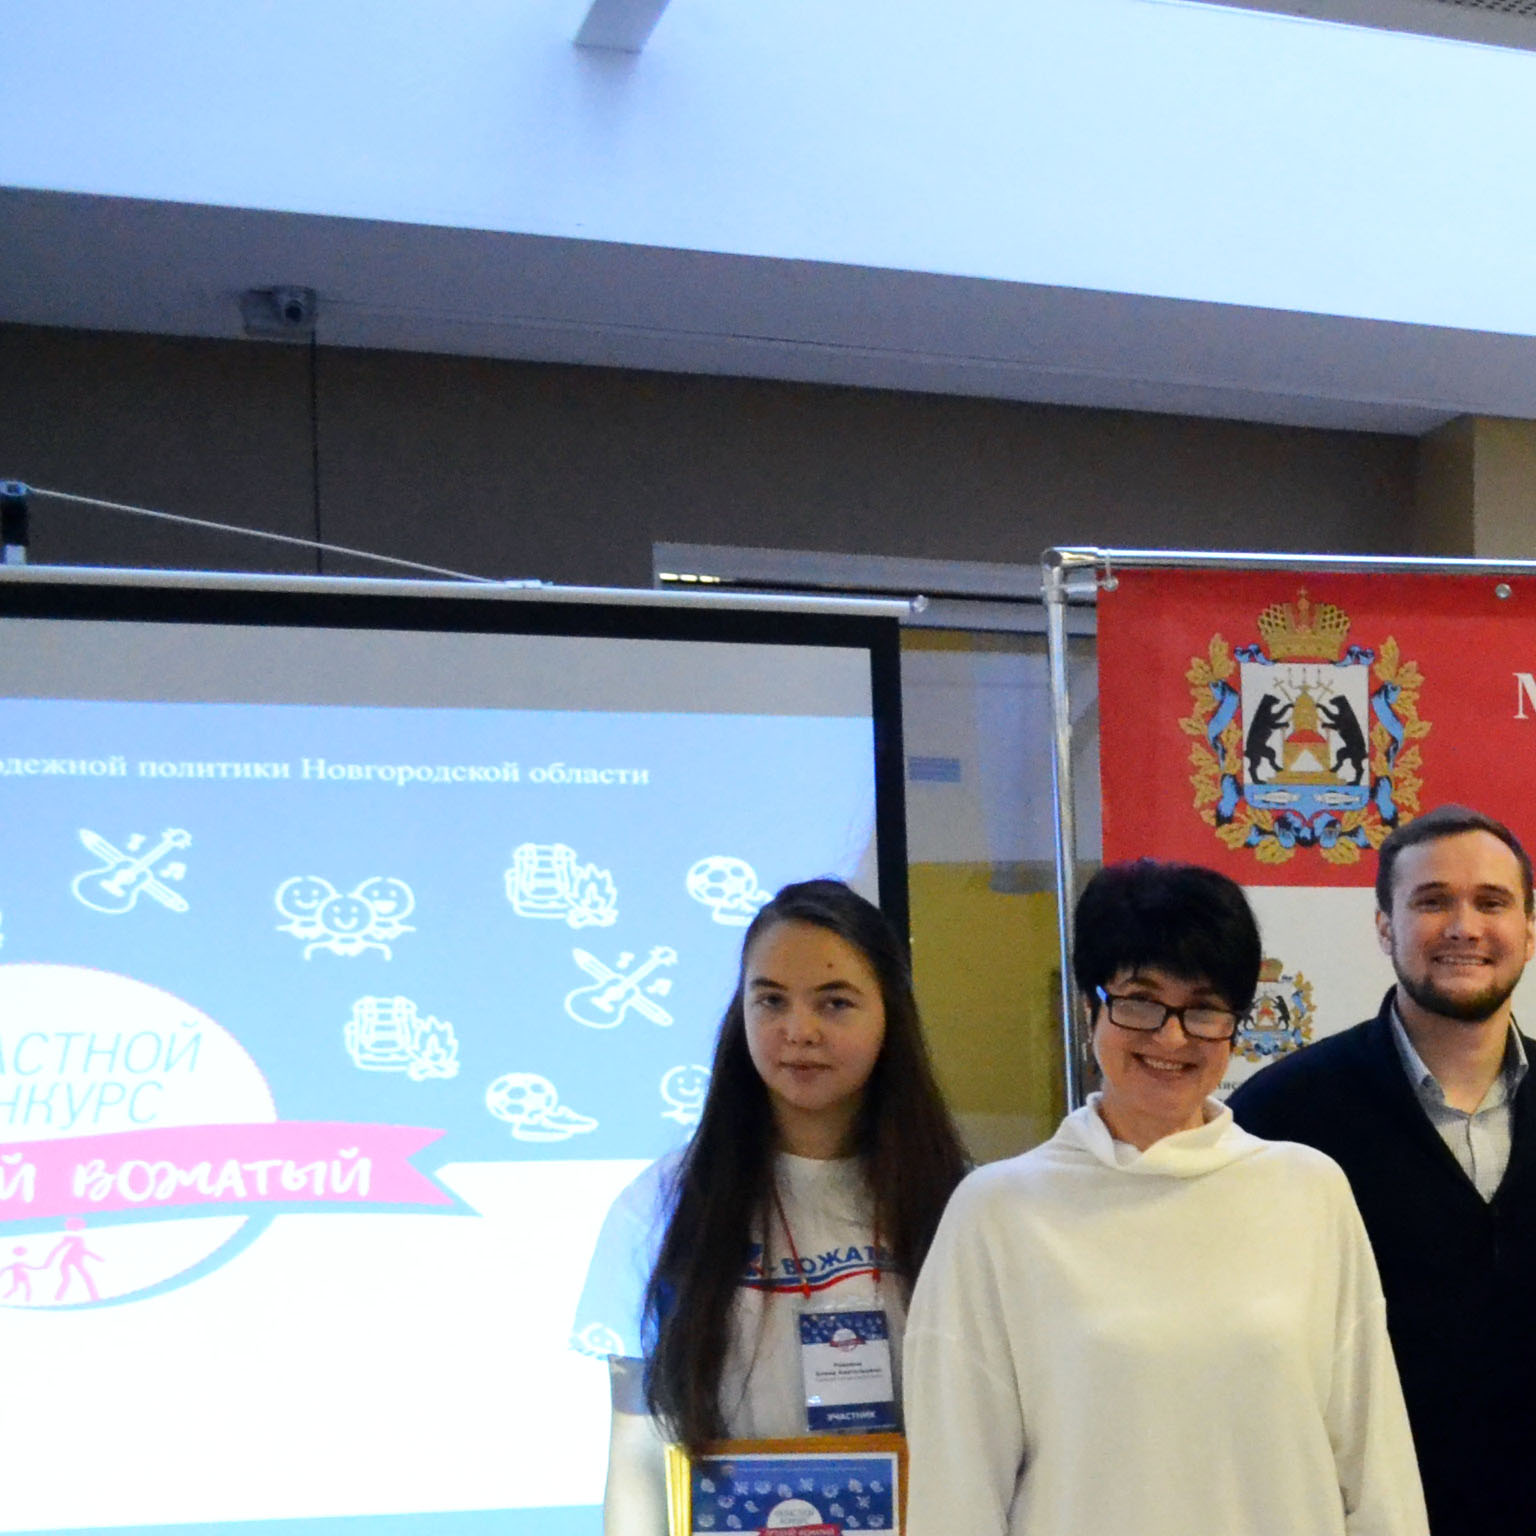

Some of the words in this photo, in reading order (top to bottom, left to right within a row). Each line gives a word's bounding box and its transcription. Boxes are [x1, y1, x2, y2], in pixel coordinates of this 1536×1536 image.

[138, 758, 290, 780] политики
[302, 757, 520, 786] Новгородской
[529, 762, 651, 786] области
[0, 1020, 203, 1077] СТНОЙ
